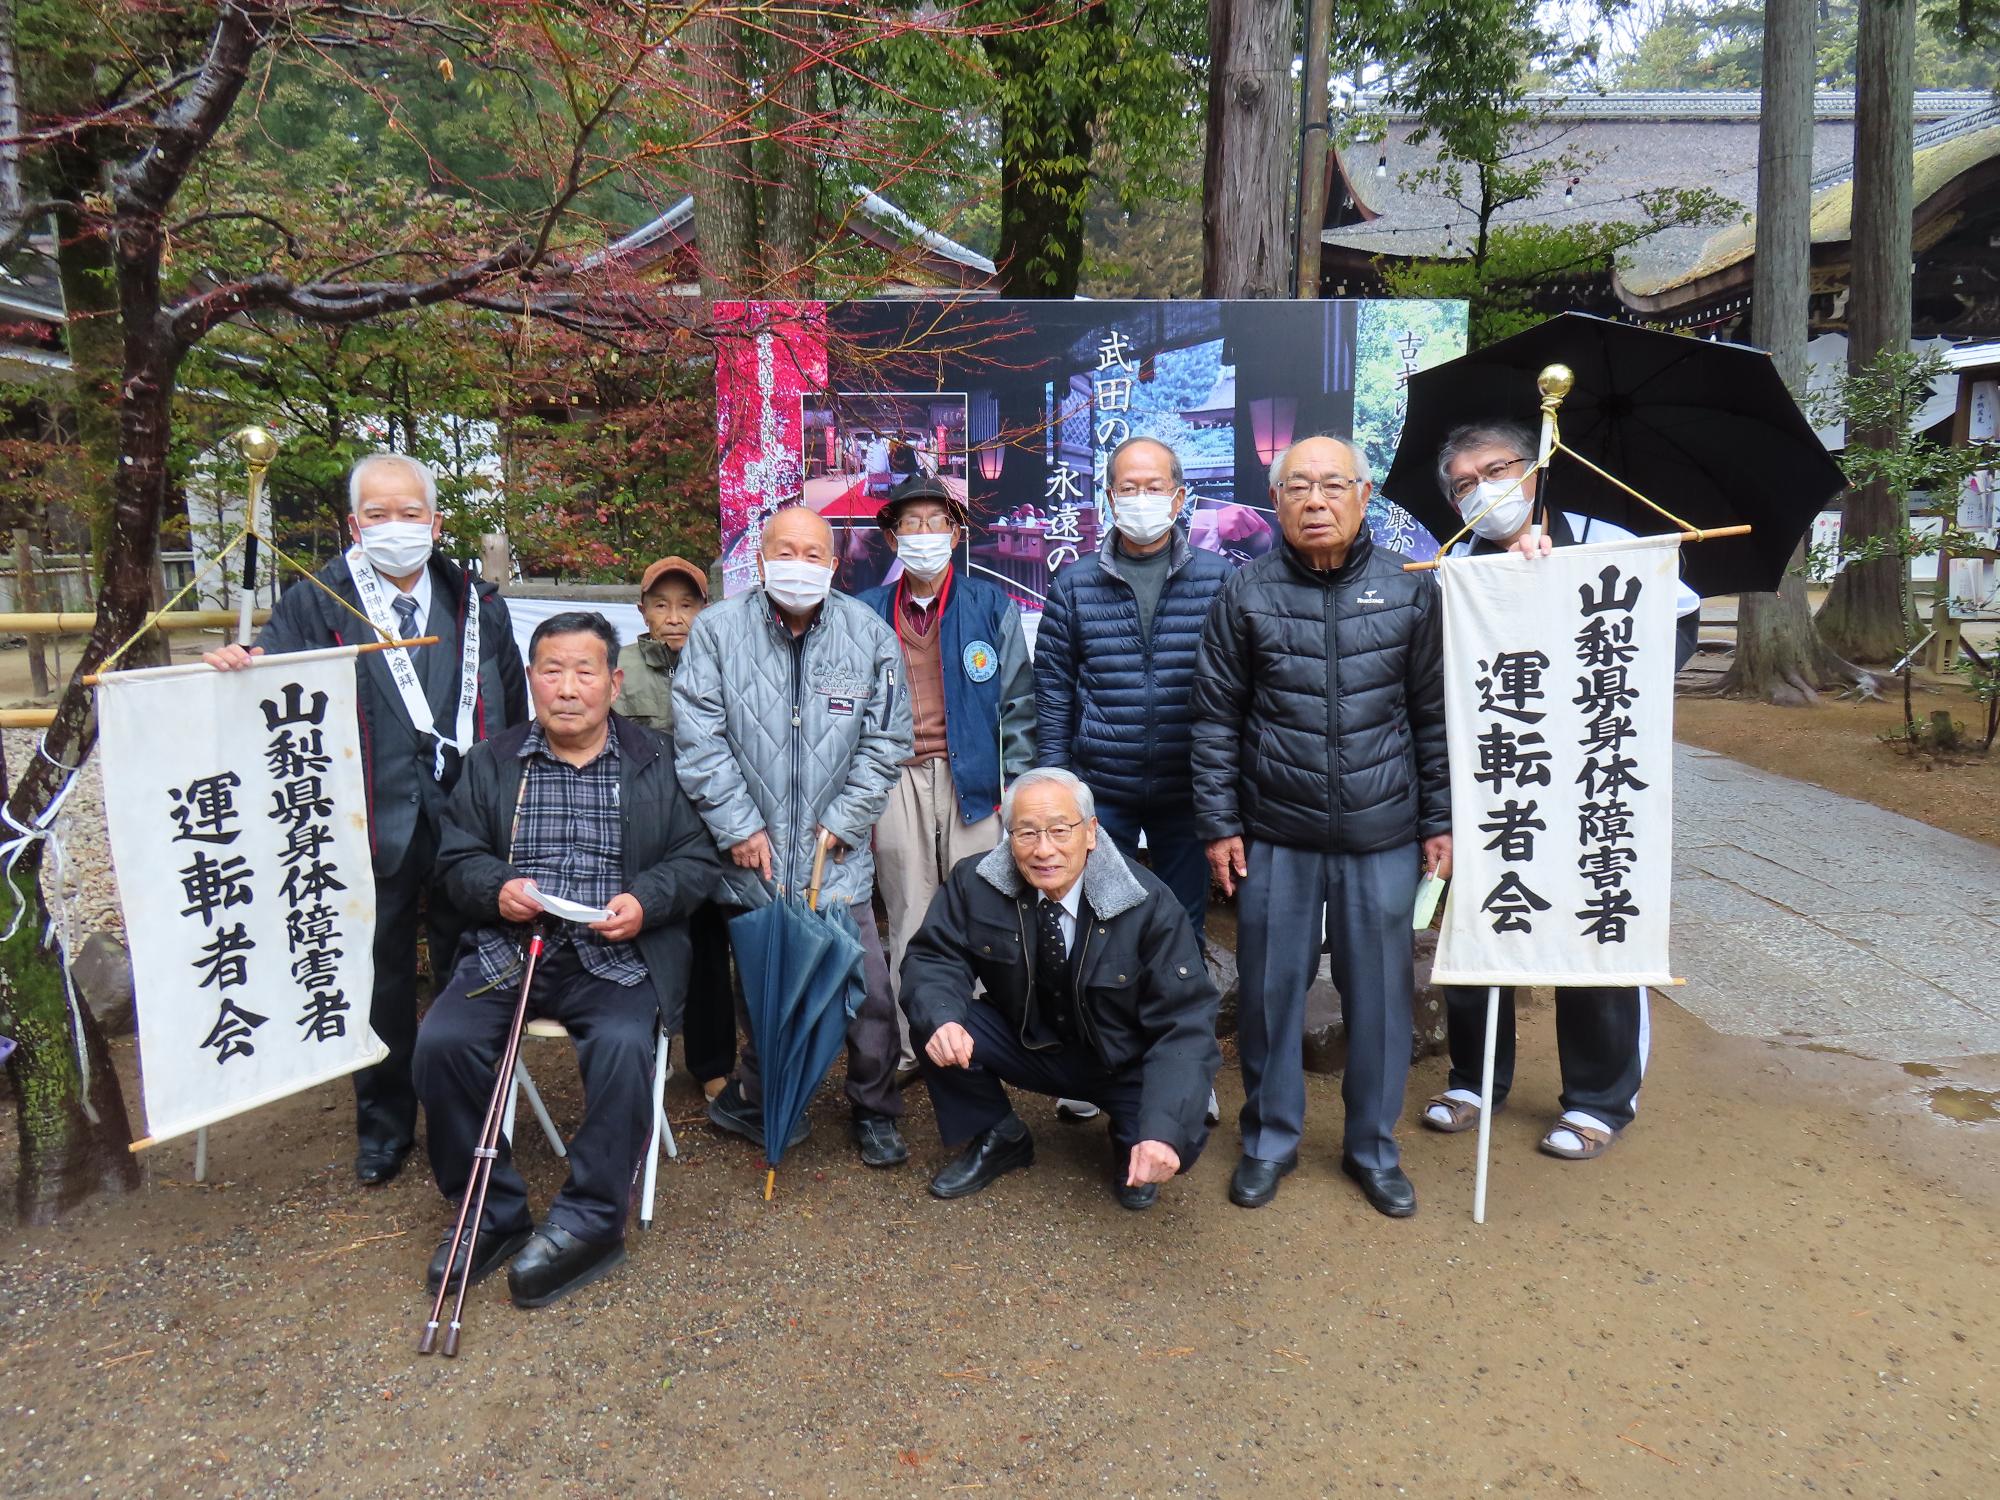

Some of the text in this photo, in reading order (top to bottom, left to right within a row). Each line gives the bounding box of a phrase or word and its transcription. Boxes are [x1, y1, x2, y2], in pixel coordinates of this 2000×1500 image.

[1044, 461, 1084, 578] 永遠の
[259, 683, 352, 1043] 山梨県身体障害者
[1473, 650, 1552, 935] 運転者会
[1572, 564, 1649, 945] 山梨県身体障害者
[168, 770, 270, 1065] 運転者会
